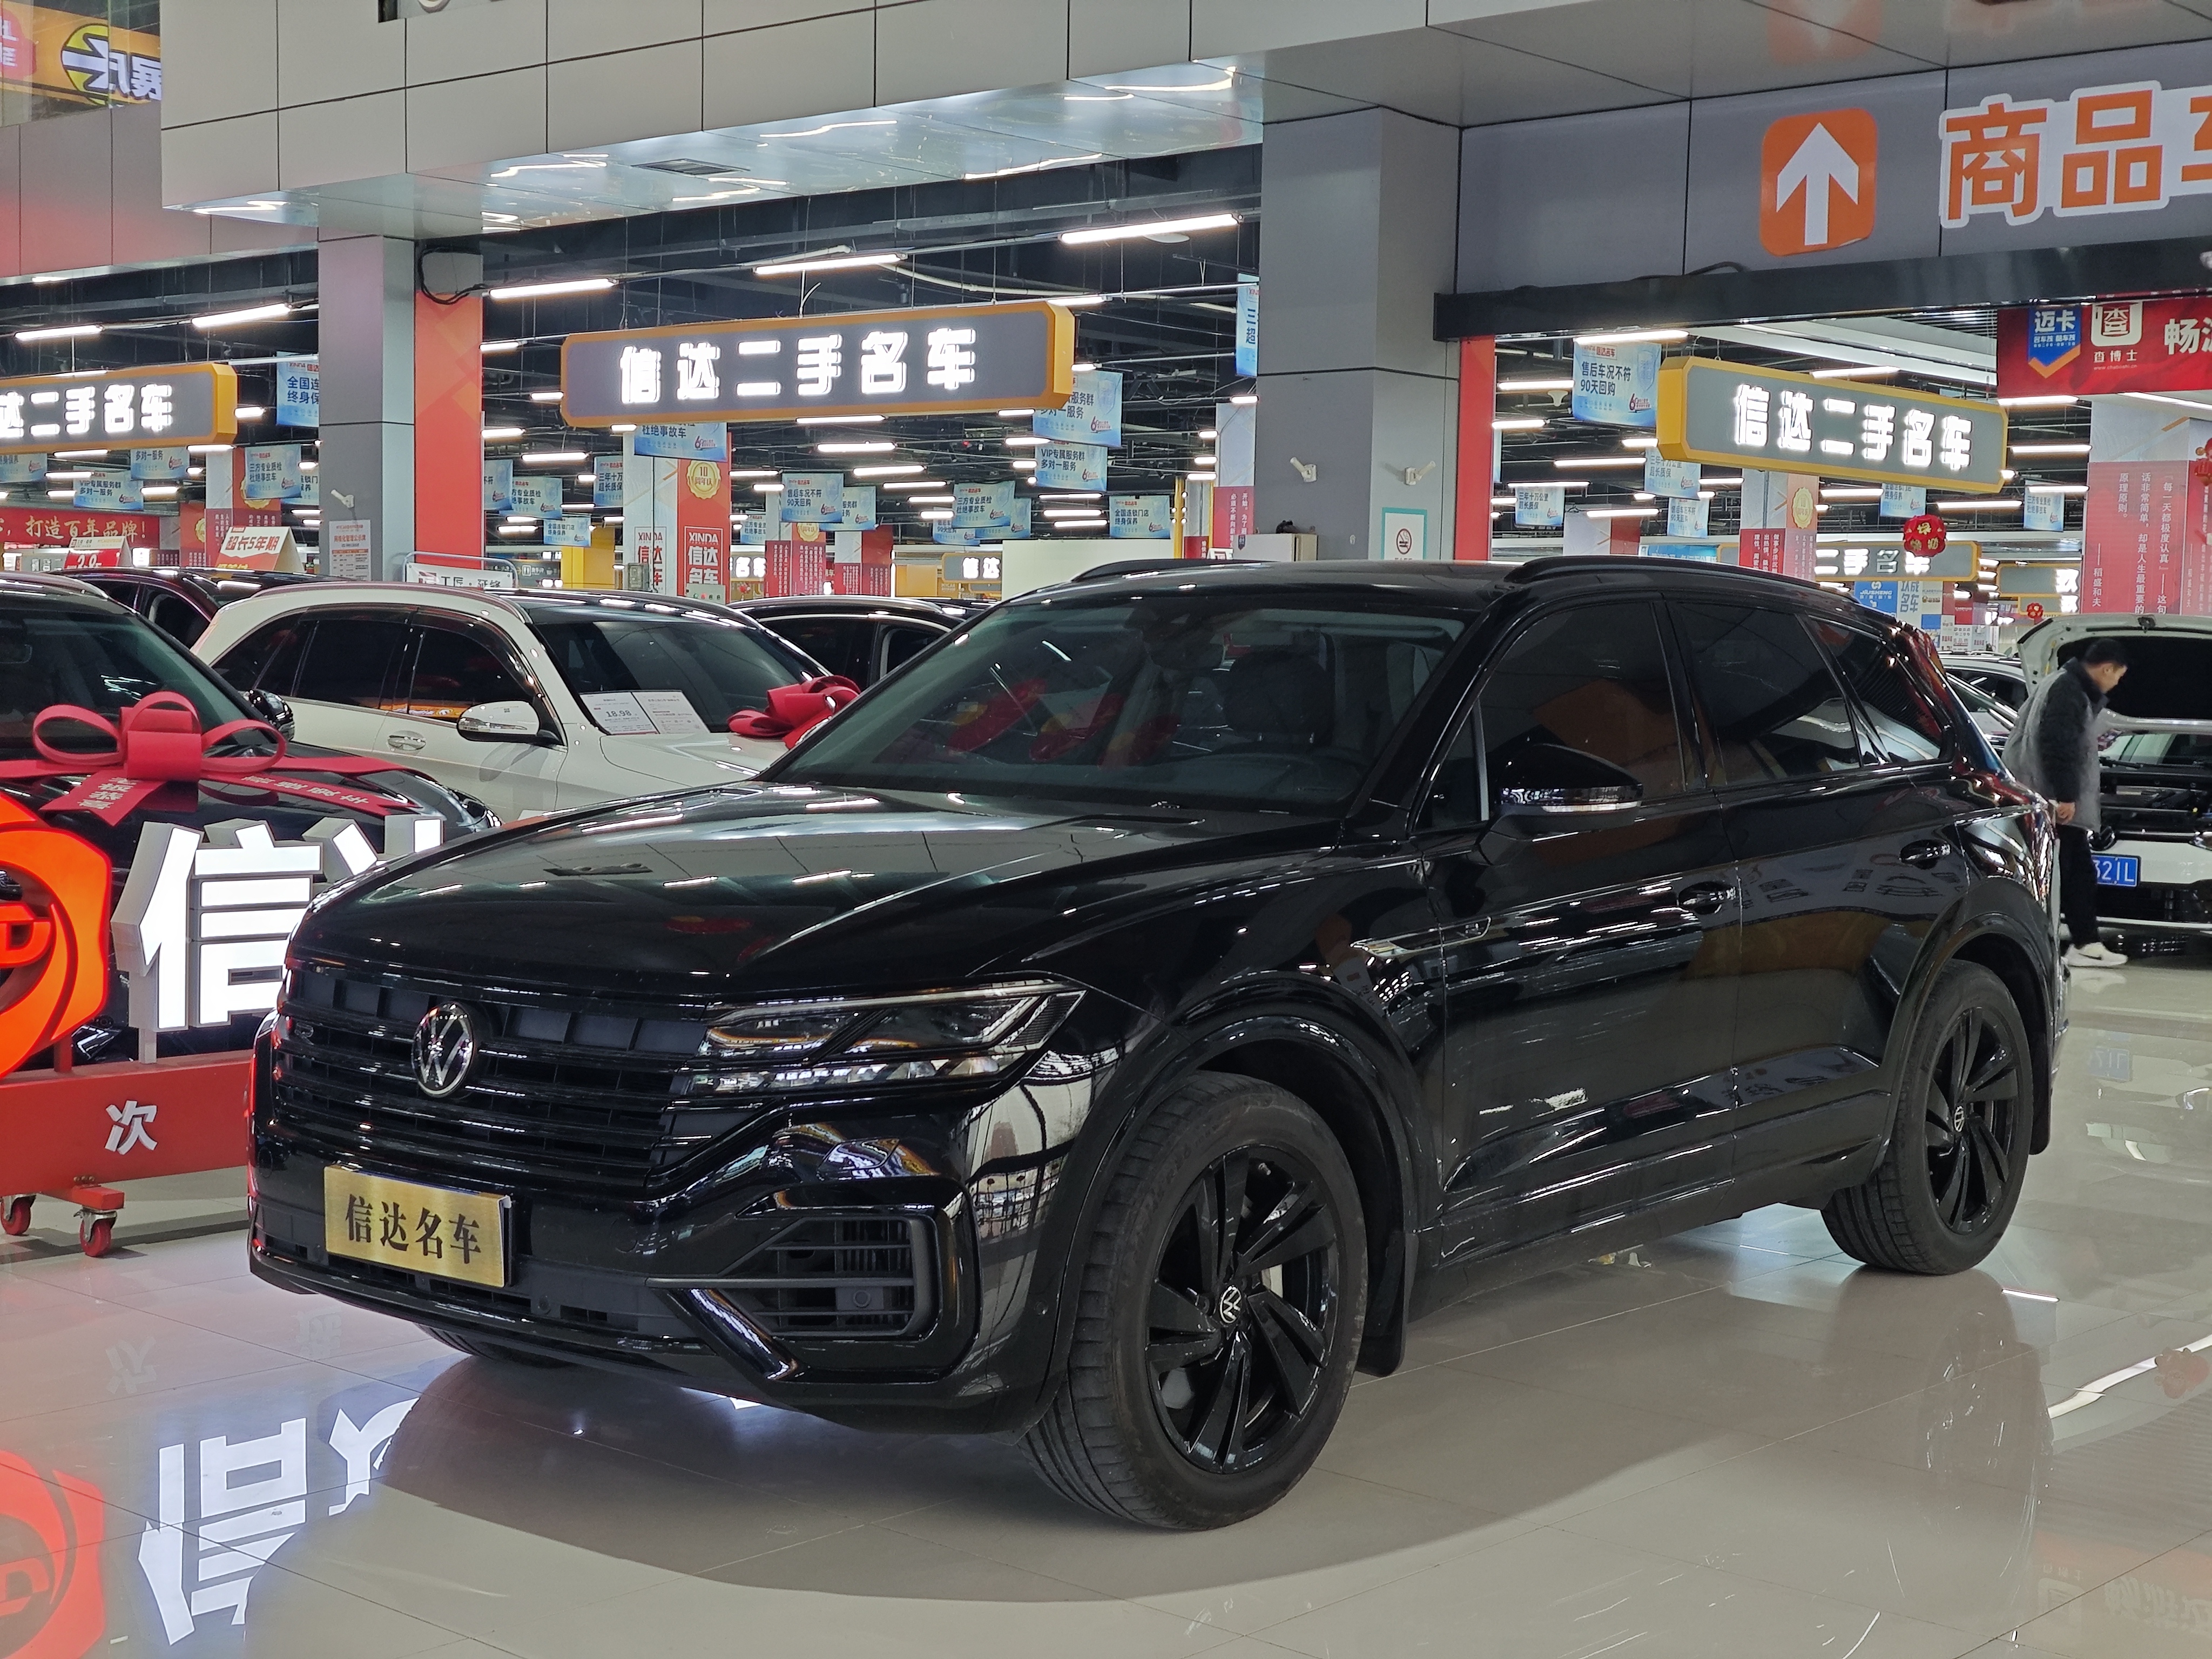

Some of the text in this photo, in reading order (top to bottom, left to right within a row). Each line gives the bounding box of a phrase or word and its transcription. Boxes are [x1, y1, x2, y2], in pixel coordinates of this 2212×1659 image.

[2034, 309, 2075, 333] 迈卡
[2164, 317, 2212, 355] 畅
[2094, 349, 2138, 363] 查博士
[619, 328, 976, 404] 信达二手名车
[1582, 361, 1631, 381] 售后车况不符
[1581, 379, 1615, 396] 90天回购
[1068, 392, 1094, 407] 服务群
[643, 425, 686, 439] 杜绝事故车
[1736, 383, 1973, 470] 信达二手名车
[1041, 449, 1085, 461] VIP专属服务群
[249, 462, 282, 472] 三方专业质检
[1041, 459, 1076, 471] 多对一服务
[79, 487, 113, 496] 多对一服务
[788, 489, 822, 498] 售后车况不符
[1519, 491, 1548, 502] 三年十万公里
[787, 498, 811, 507] 90天回购
[957, 496, 992, 505] 三方专业质检
[1115, 509, 1149, 517] 全国连锁门店
[1115, 517, 1138, 525] 终身保养
[689, 532, 719, 543] XINDA
[688, 545, 719, 567] 信达
[1900, 593, 1919, 613] 名车
[605, 710, 632, 718] 18.98
[105, 1100, 158, 1154] 次
[345, 1193, 482, 1264] 信达名车
